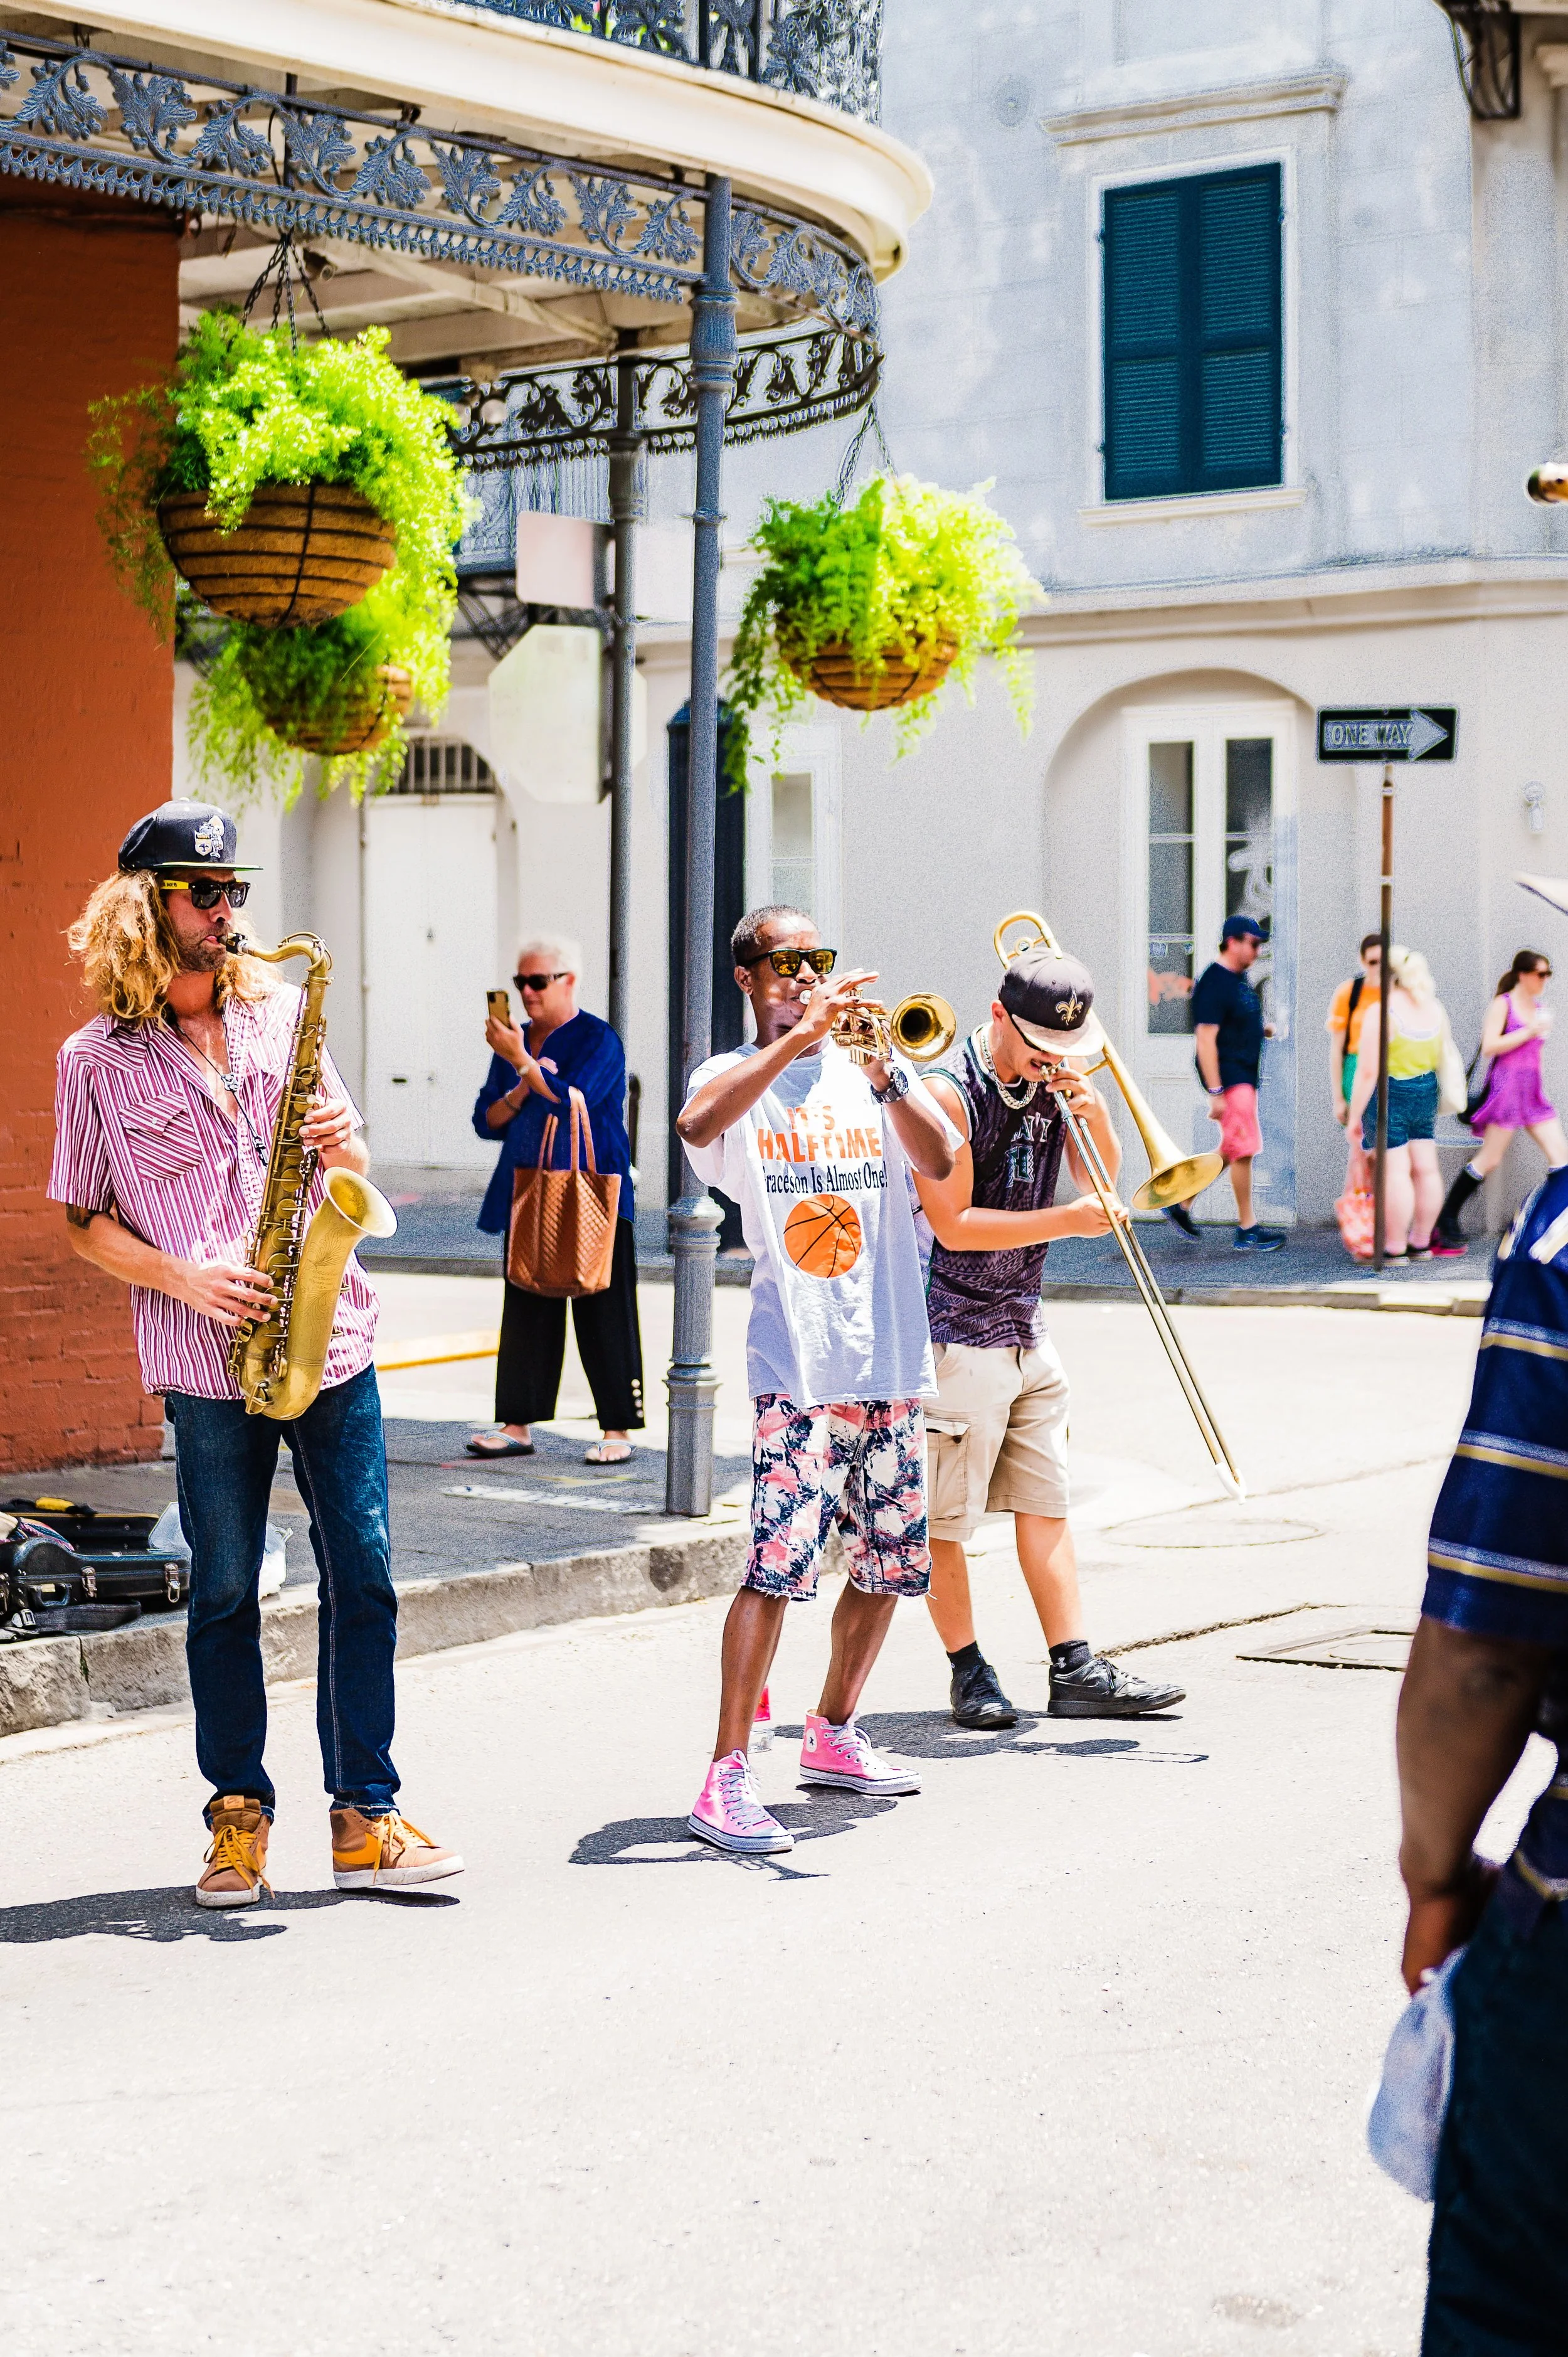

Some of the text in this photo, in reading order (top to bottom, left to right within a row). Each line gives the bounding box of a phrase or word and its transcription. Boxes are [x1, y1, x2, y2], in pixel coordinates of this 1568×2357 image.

[1332, 724, 1412, 745] ONE WAY
[757, 1127, 882, 1163] HALFTIME
[763, 1160, 888, 1193] raceson Is Almost One!
